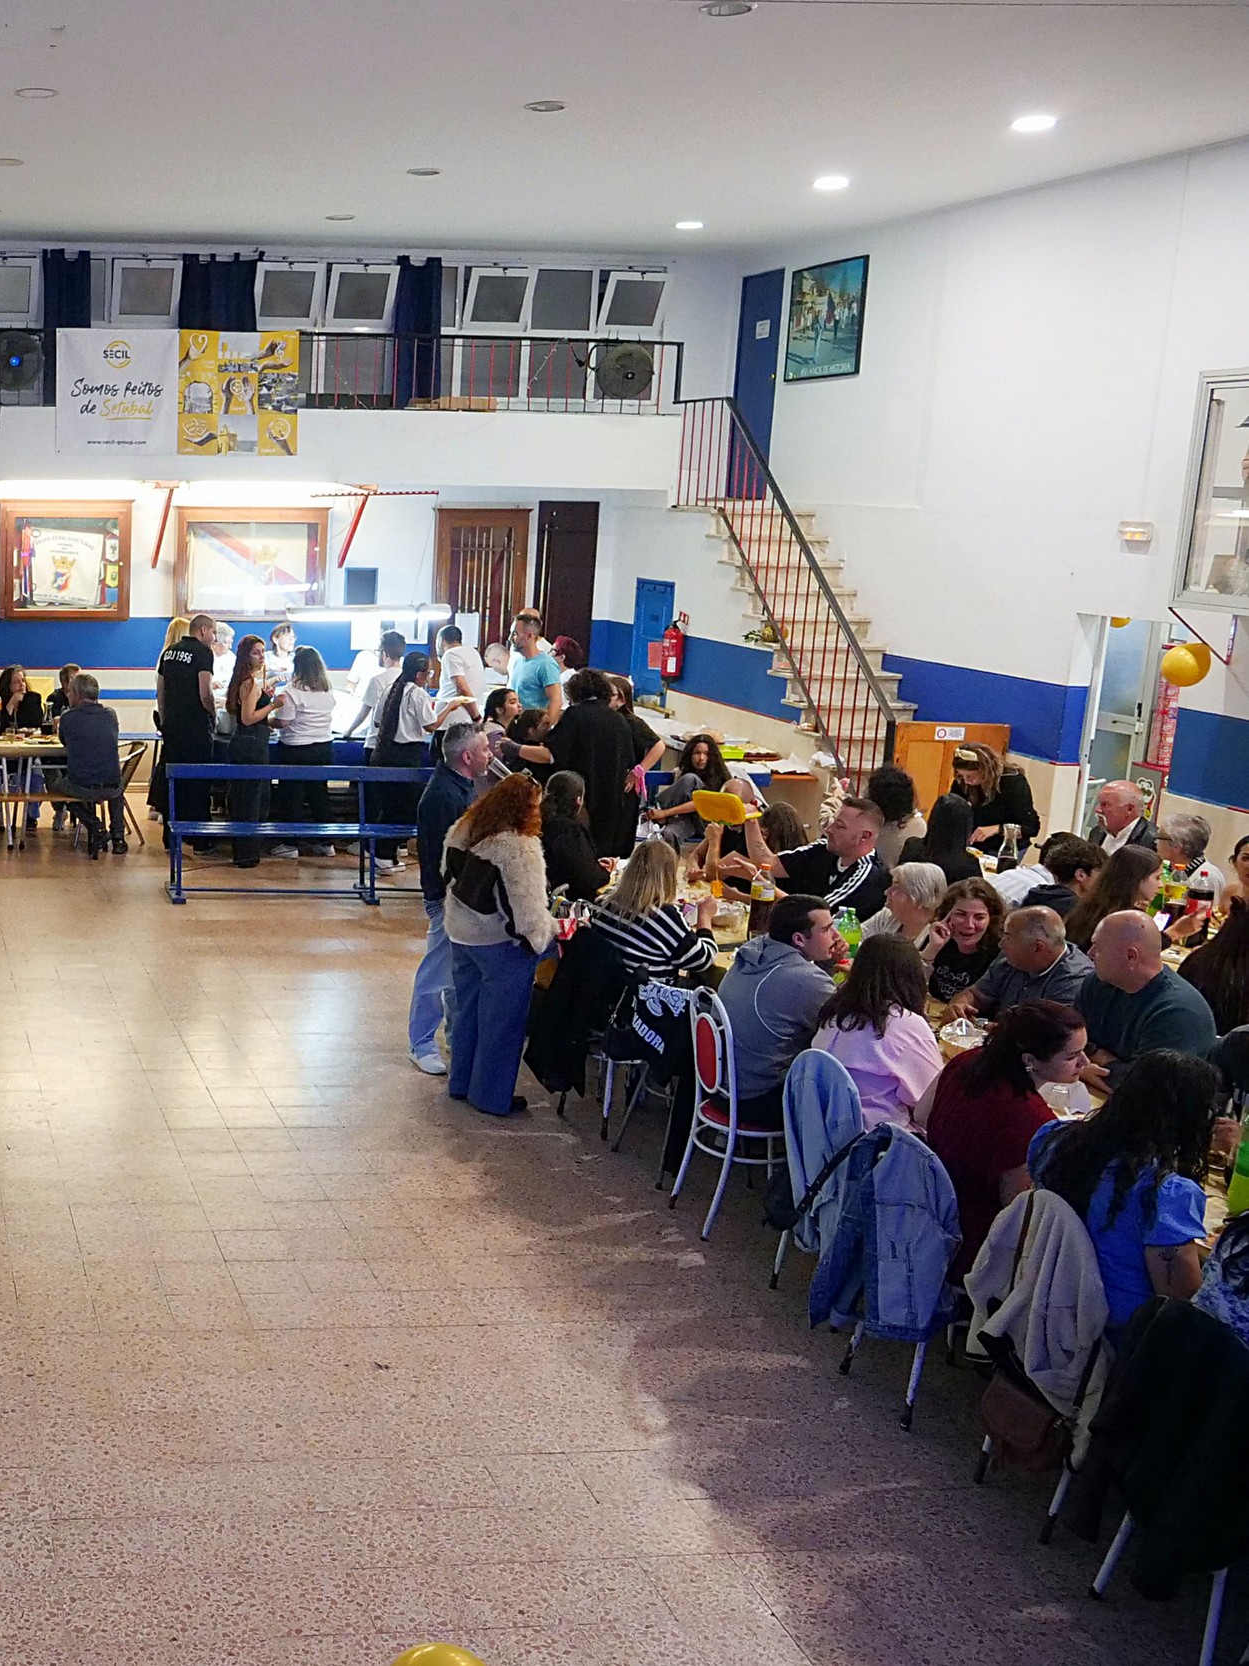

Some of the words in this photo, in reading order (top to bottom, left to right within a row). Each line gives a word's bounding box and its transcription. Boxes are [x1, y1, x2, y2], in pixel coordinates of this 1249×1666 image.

[103, 349, 131, 359] SECIL
[70, 377, 120, 397] Somos
[79, 399, 97, 414] de
[176, 650, 193, 664] 1956
